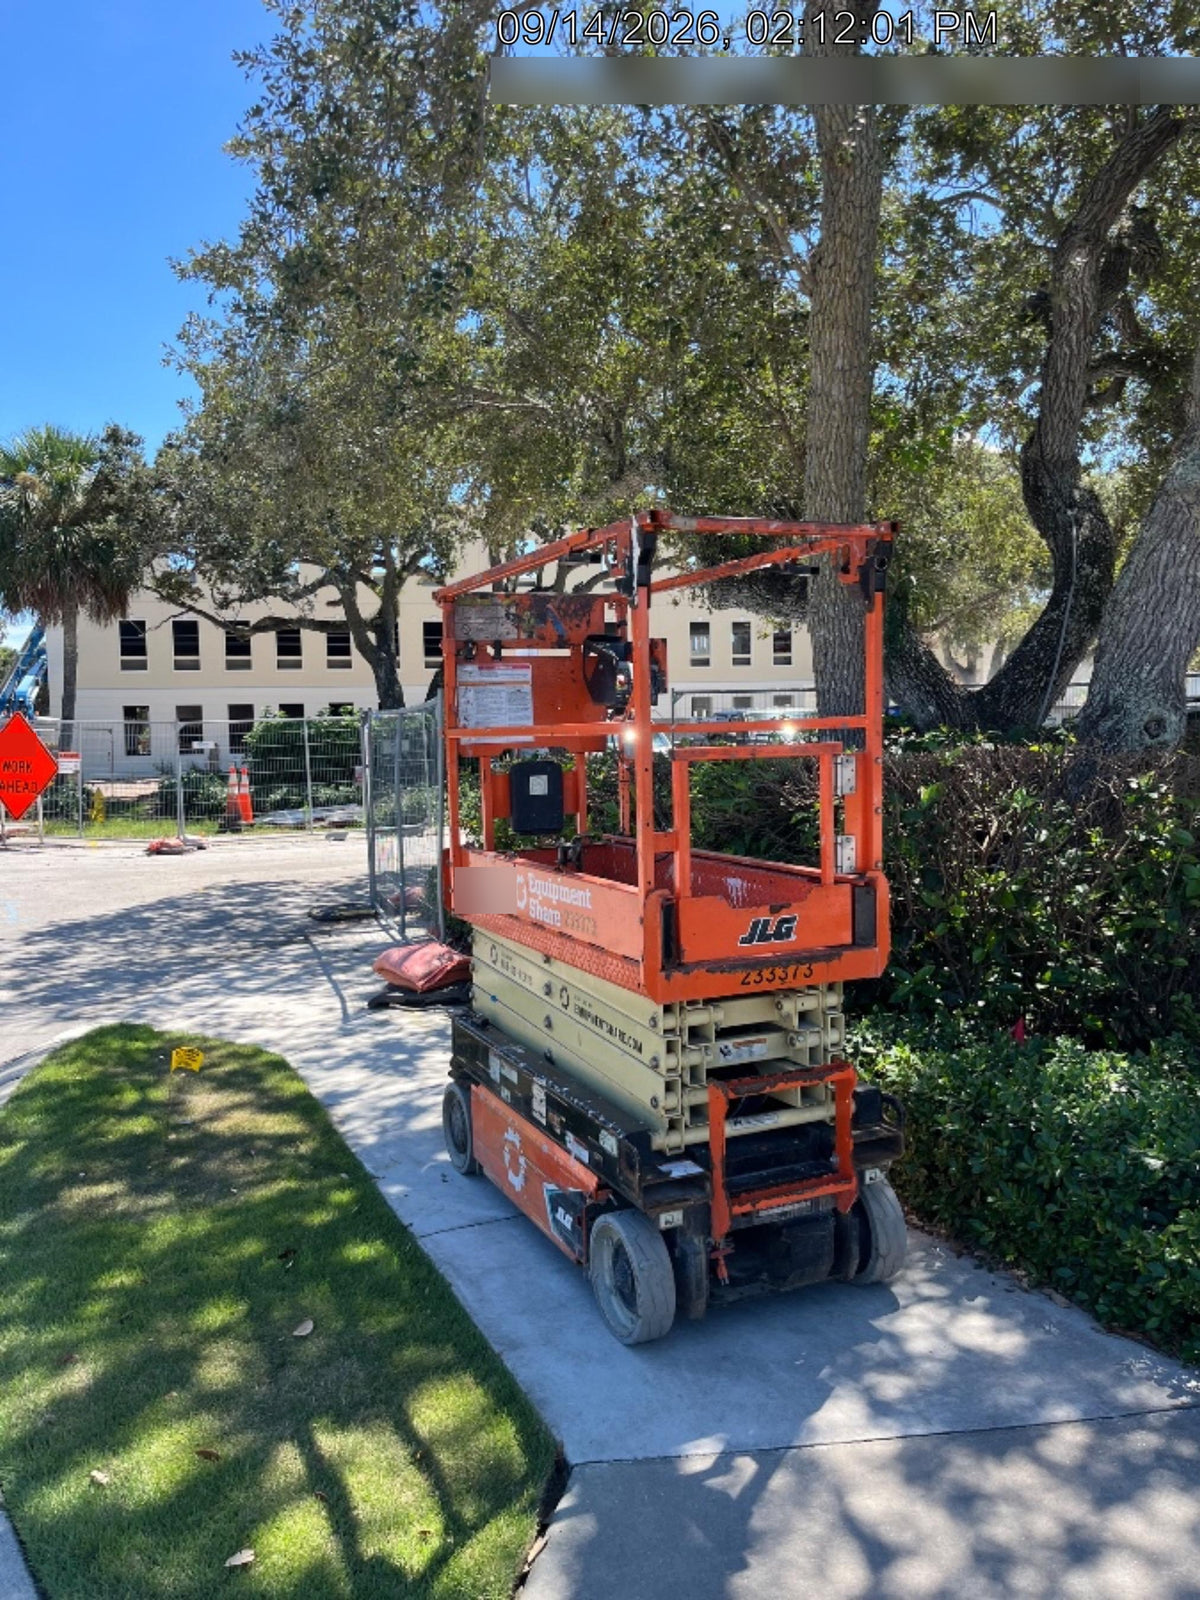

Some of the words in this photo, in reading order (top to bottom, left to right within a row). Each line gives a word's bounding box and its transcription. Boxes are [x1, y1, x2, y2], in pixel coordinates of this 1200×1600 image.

[3, 760, 32, 773] WORK
[527, 872, 592, 910] Equipment
[529, 897, 562, 927] Share
[737, 913, 799, 947] JLG
[740, 963, 814, 986] 233373
